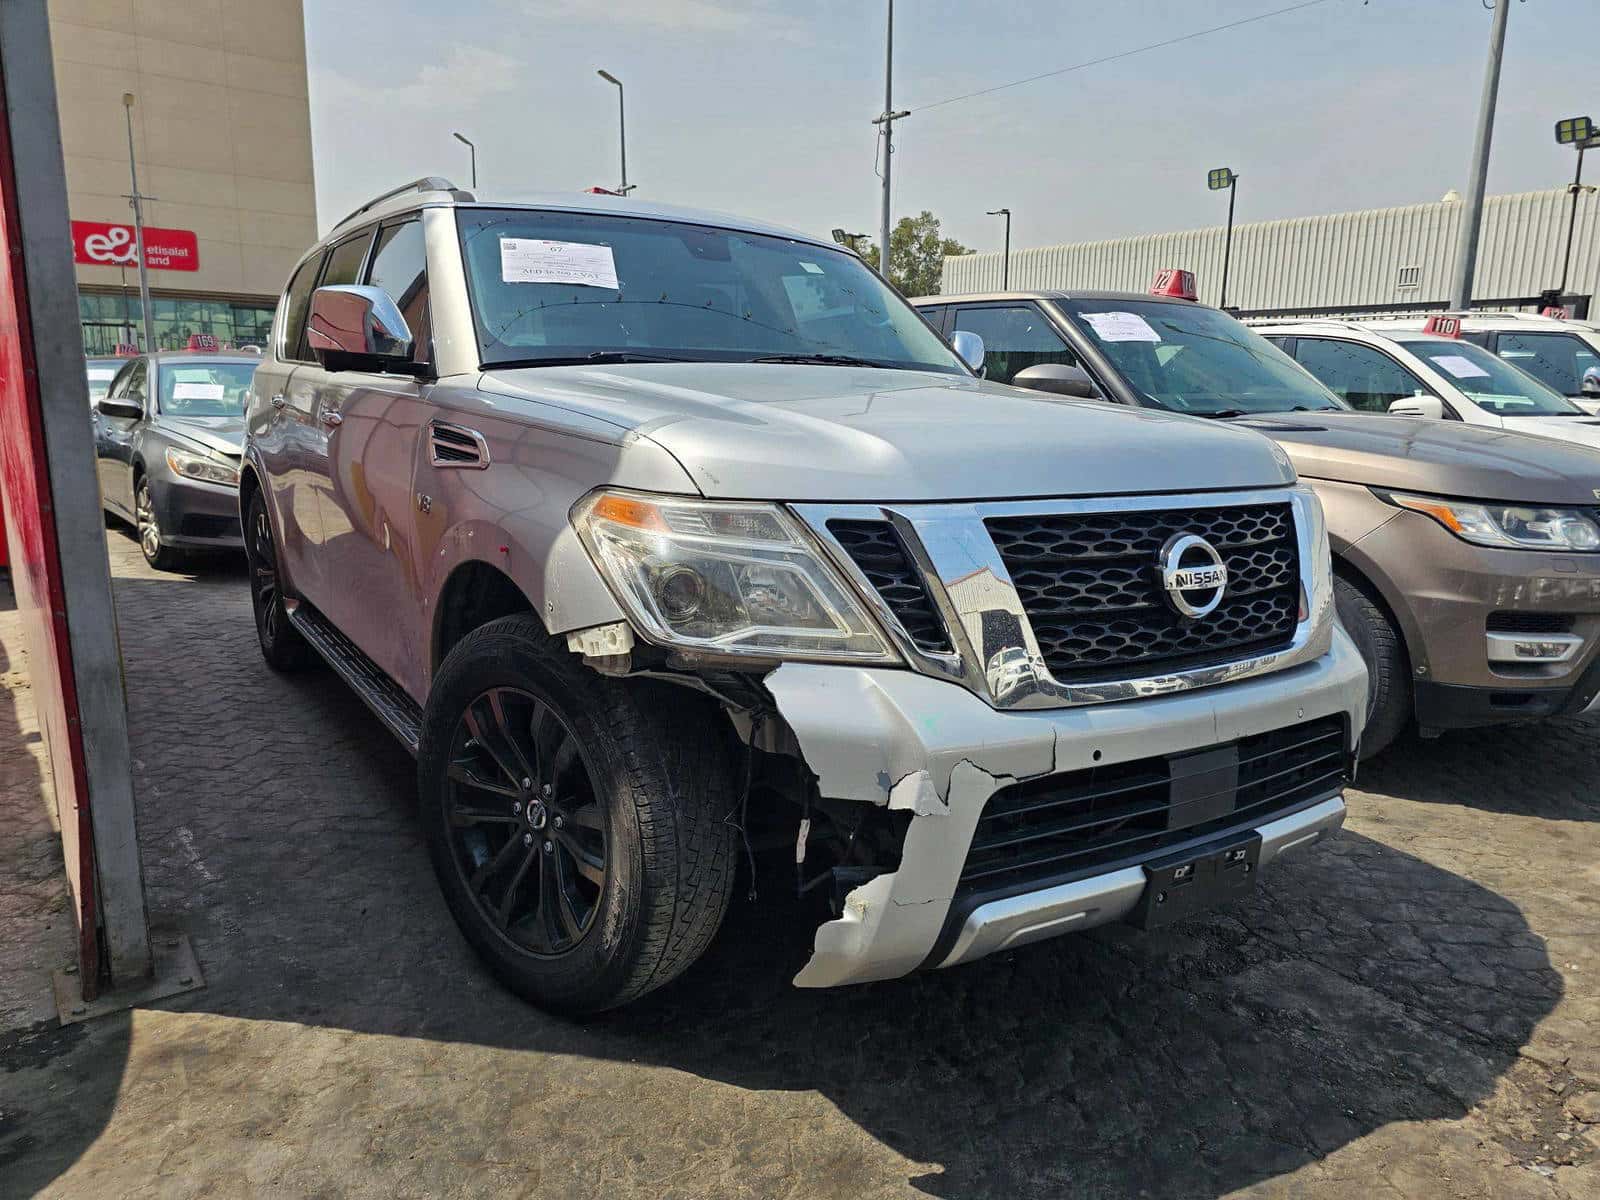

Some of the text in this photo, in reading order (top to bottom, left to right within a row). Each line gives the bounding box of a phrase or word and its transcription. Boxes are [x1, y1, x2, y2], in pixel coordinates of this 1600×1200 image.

[146, 245, 188, 257] etisalat
[148, 256, 170, 265] and
[1154, 270, 1171, 288] 72
[1435, 318, 1455, 333] 110
[197, 335, 213, 347] 169
[1175, 570, 1226, 588] NISSAN
